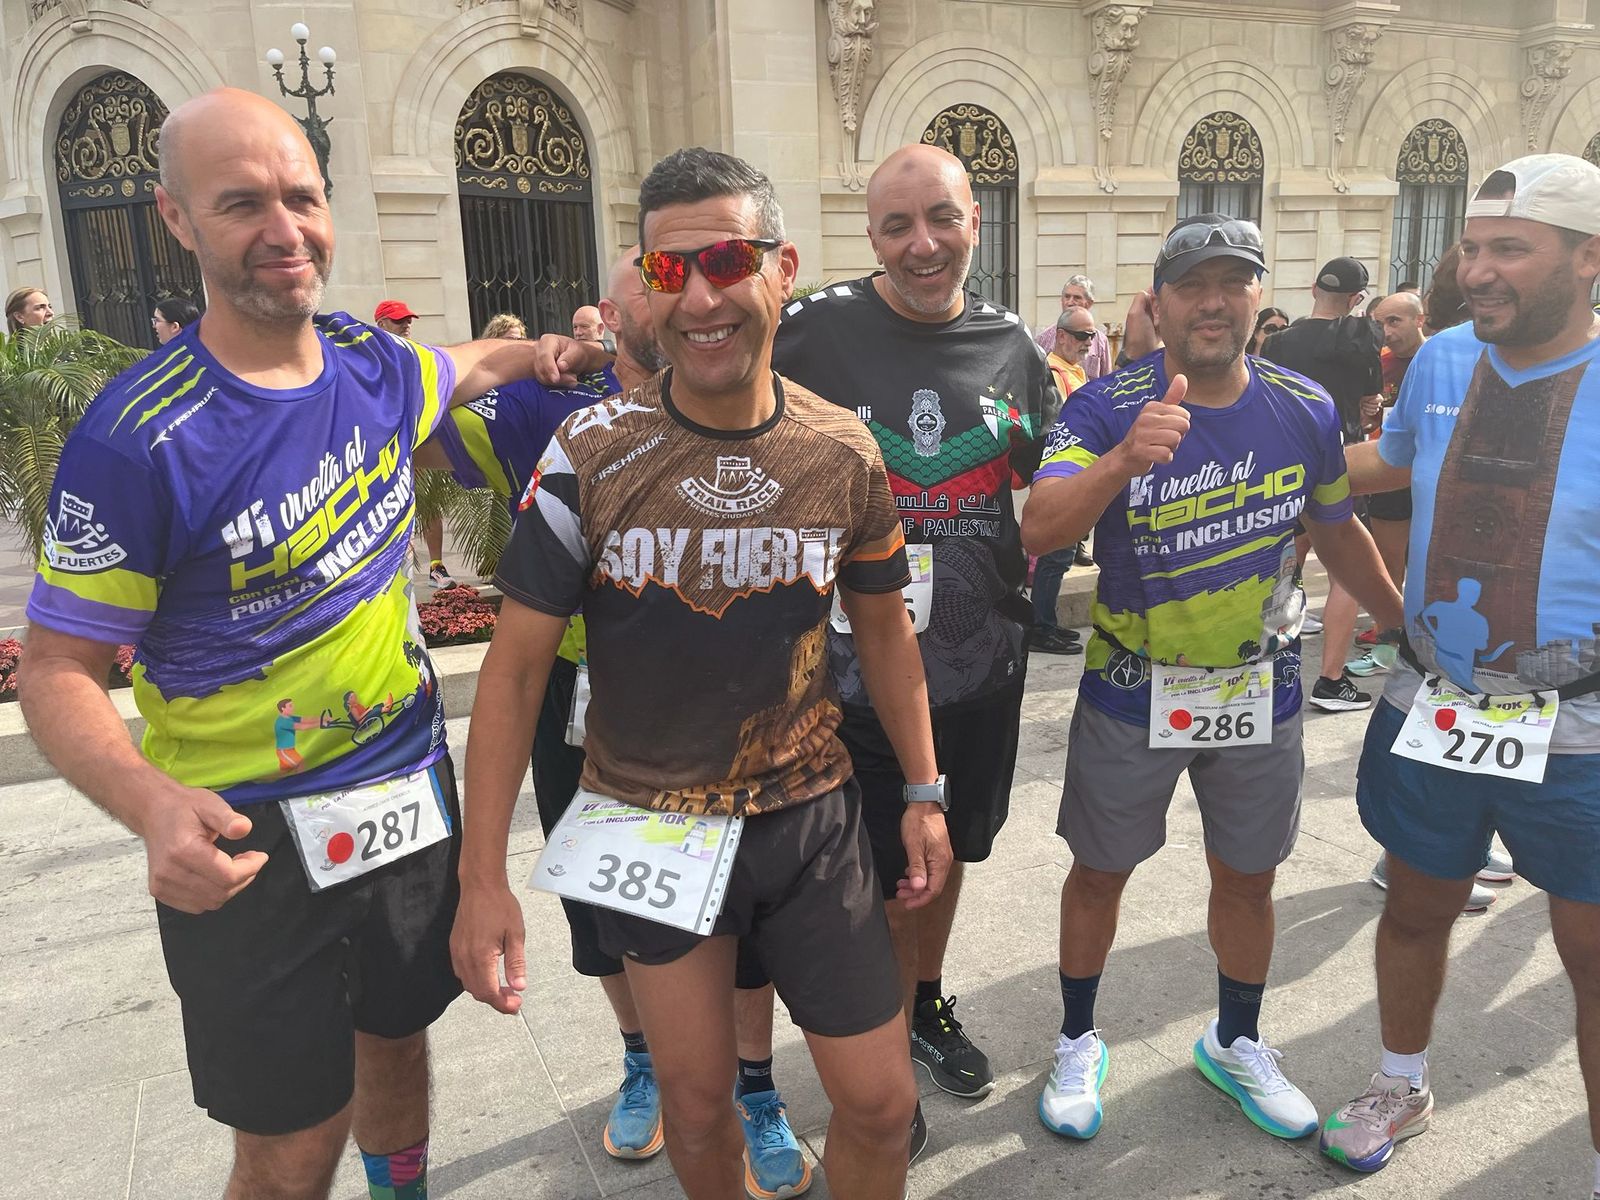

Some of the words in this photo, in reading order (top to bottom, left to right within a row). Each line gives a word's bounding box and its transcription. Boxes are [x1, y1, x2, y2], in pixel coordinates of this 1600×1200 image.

[280, 450, 342, 531] vuelta
[344, 425, 367, 474] al
[590, 431, 668, 485] FIREHAWK
[1160, 460, 1228, 503] vuelta
[1231, 451, 1257, 489] al
[687, 480, 733, 511] TRAIL
[738, 479, 778, 511] RACE
[687, 497, 720, 519] FUERTES
[721, 511, 754, 520] CIUDAD
[755, 507, 766, 515] DE
[766, 487, 785, 509] CEUTA
[1176, 494, 1306, 553] INCLUSIÓN
[57, 549, 122, 568] FUERTES
[597, 527, 692, 589] SOY
[231, 594, 282, 621] POR
[285, 580, 318, 600] LA
[1191, 711, 1255, 742] 286
[1442, 728, 1524, 770] 270
[357, 800, 420, 861] 287
[606, 814, 651, 824] INCLUSIÓN
[588, 853, 682, 910] 385
